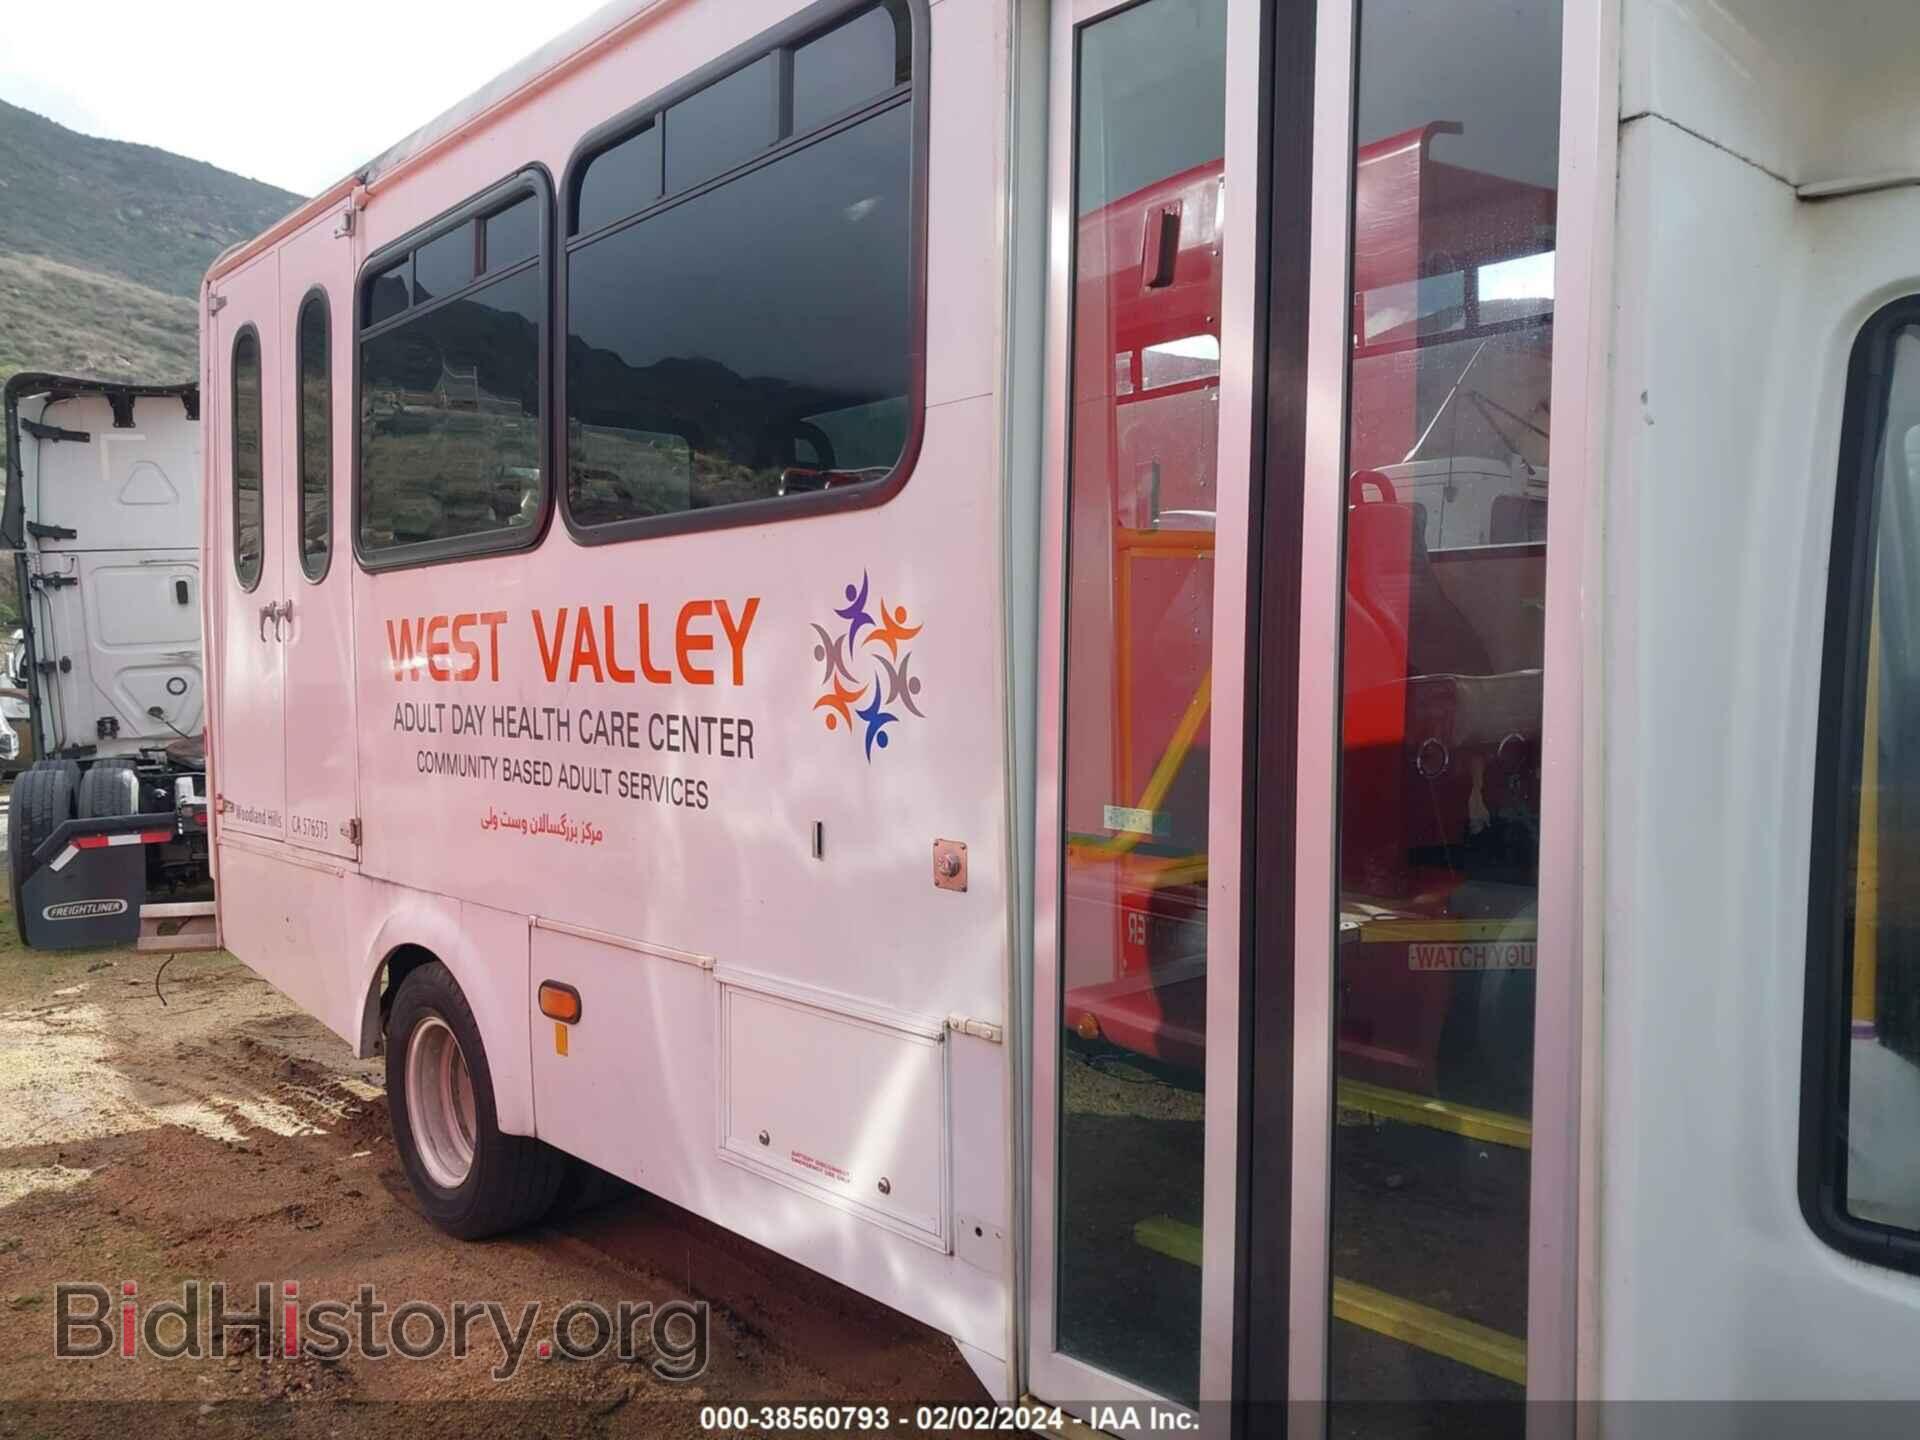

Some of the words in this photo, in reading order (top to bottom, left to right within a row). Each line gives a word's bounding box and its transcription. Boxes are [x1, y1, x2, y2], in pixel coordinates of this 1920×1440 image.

[386, 611, 508, 682] WEST
[531, 597, 761, 686] VALLEY
[394, 702, 446, 733] ADULT
[451, 703, 486, 735] DAY
[492, 705, 571, 742] HEALTH
[578, 708, 640, 749] CARE
[648, 712, 754, 759] CENTER
[416, 750, 498, 780] COMMUNITY
[502, 758, 553, 787] BASED
[558, 763, 612, 795] ADULT
[618, 770, 709, 810] SERVICES
[291, 815, 301, 833] CA
[50, 902, 121, 917] FREIGHTLINER
[1415, 945, 1487, 969] WATCH
